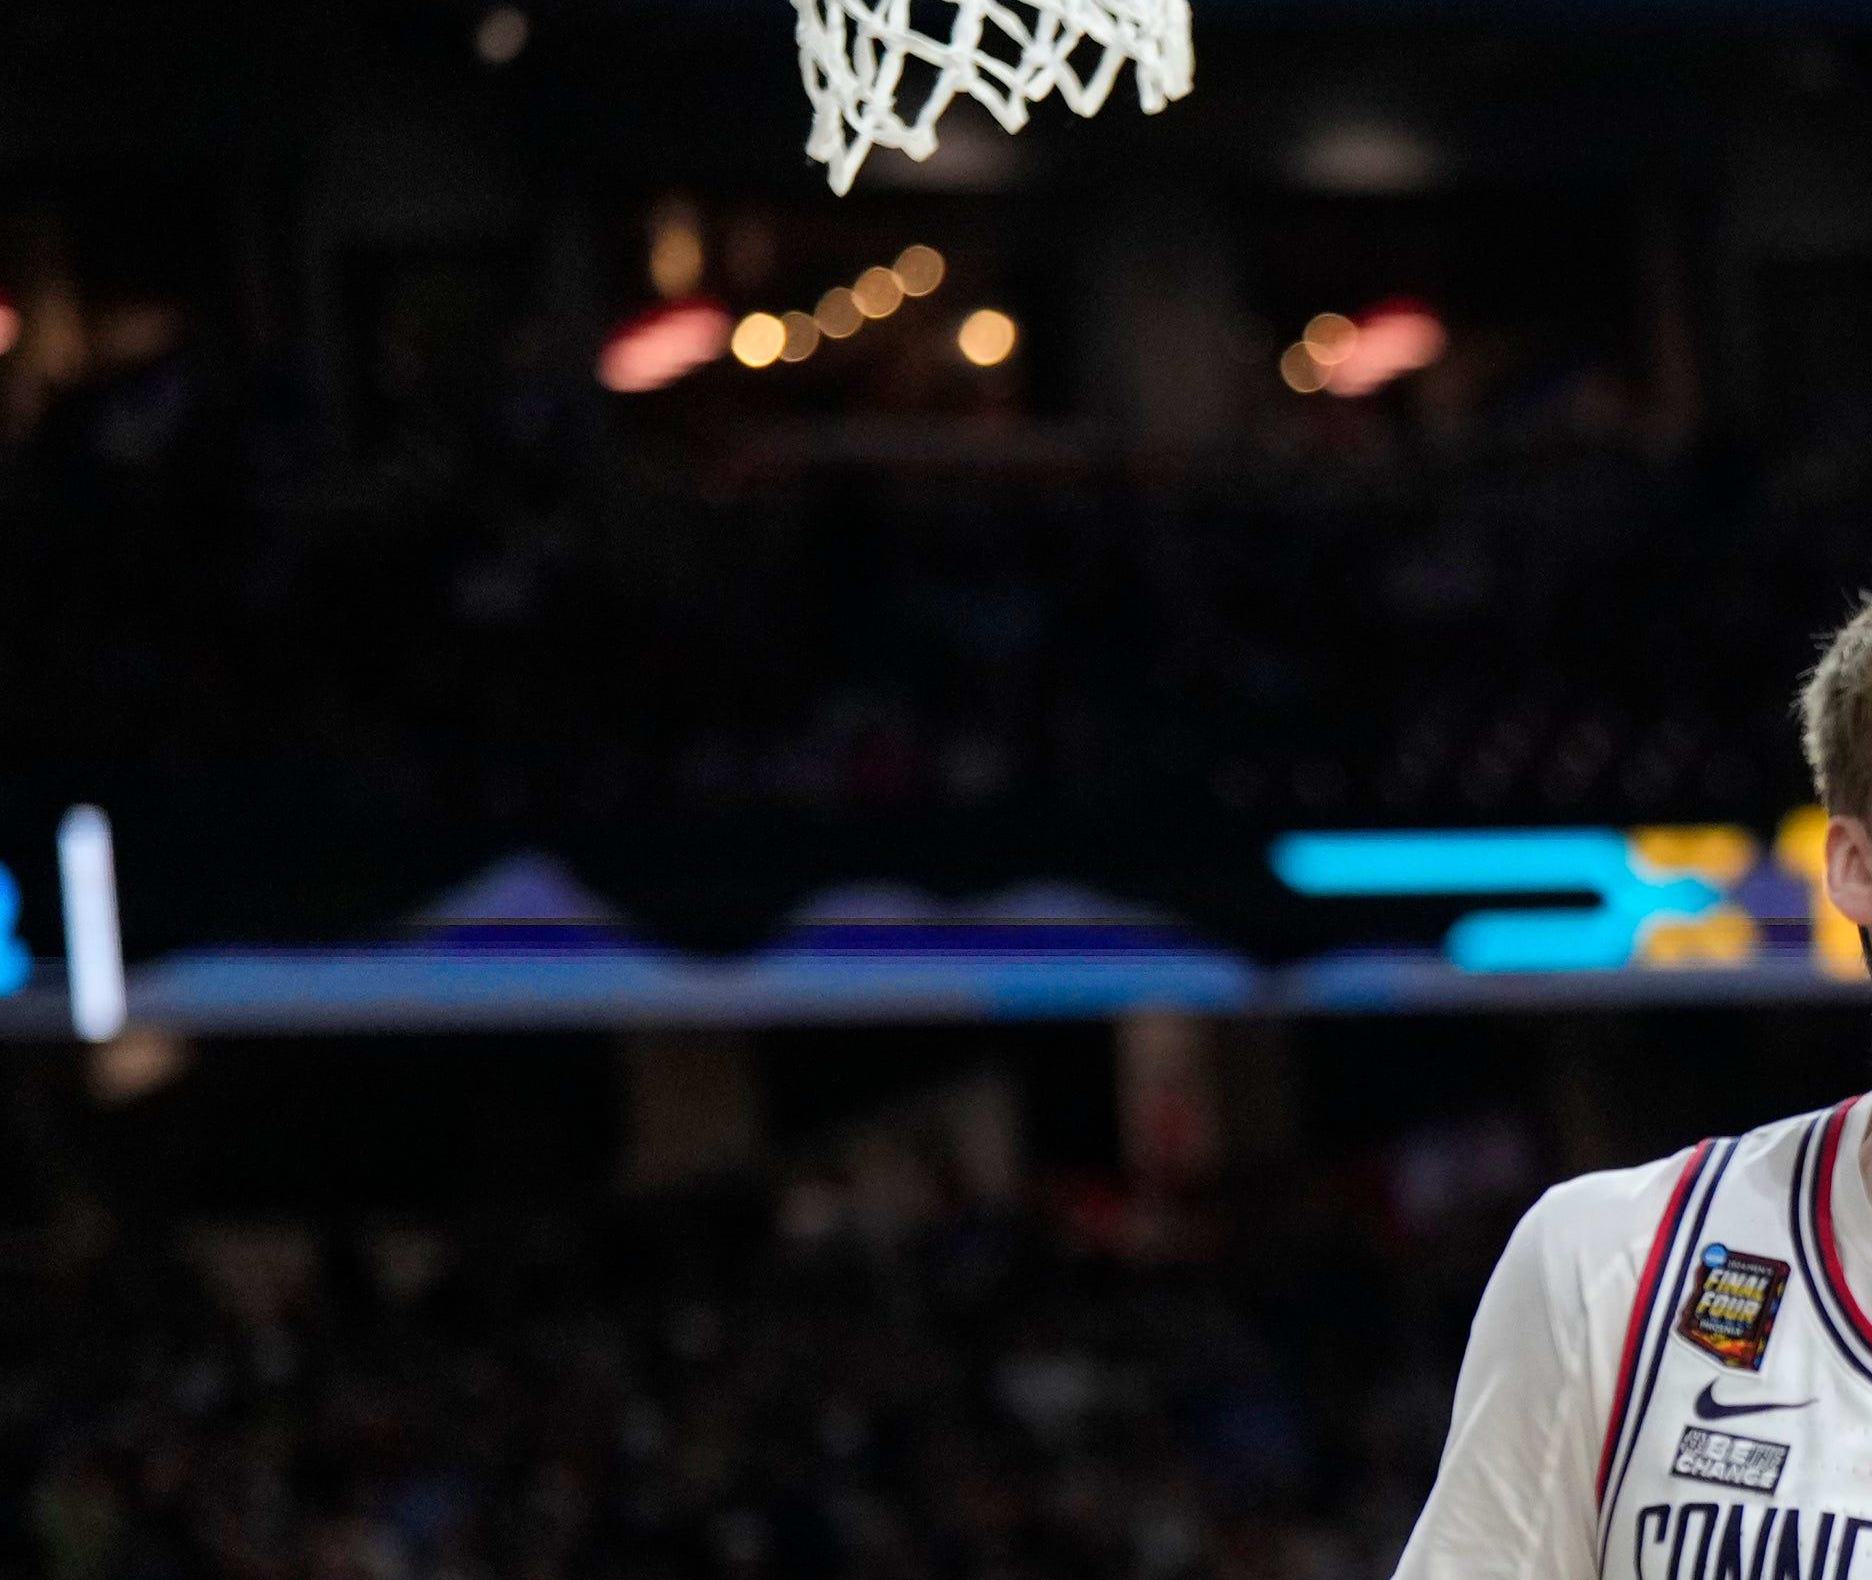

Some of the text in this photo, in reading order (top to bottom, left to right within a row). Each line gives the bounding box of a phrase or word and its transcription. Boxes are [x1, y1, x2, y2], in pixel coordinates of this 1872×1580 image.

[1704, 1268, 1770, 1301] FINAL
[1695, 1290, 1761, 1323] FOUR
[1706, 1434, 1754, 1464] BE
[1676, 1454, 1777, 1489] CHANGE
